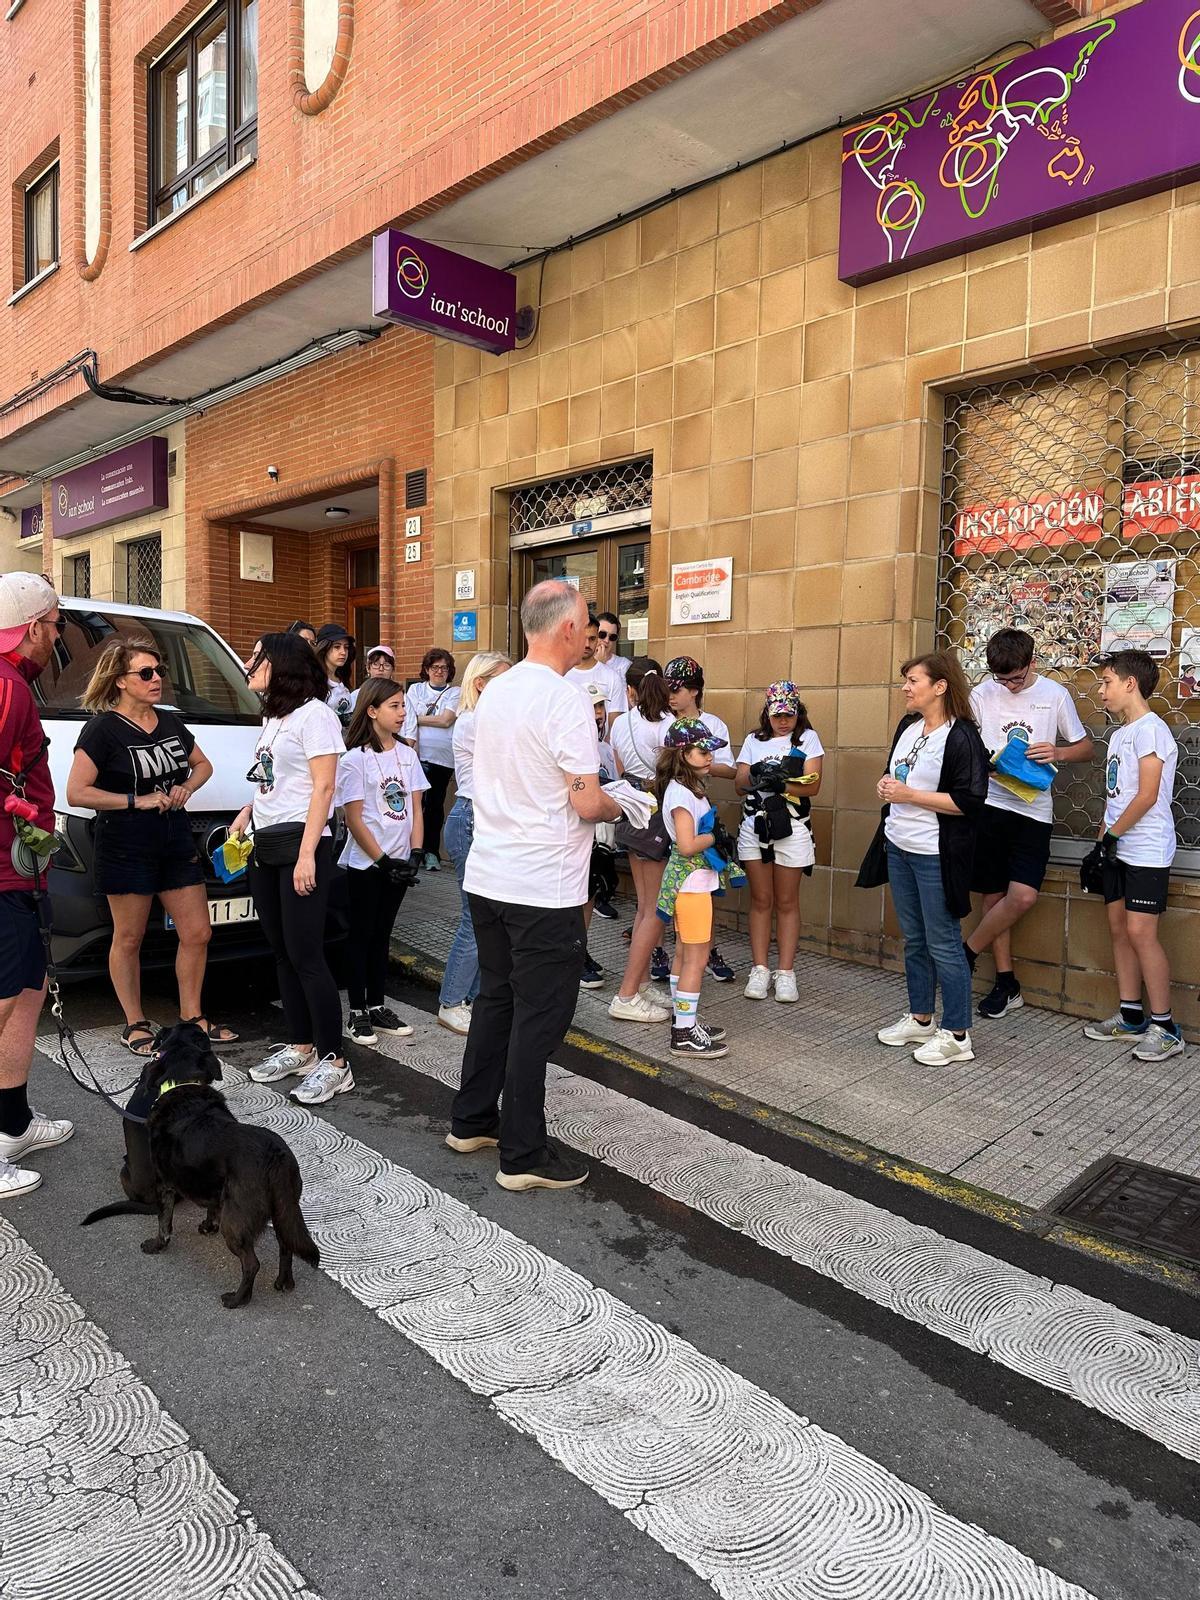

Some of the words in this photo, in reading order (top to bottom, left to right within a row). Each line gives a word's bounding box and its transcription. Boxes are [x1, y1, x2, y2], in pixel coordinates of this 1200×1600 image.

[430, 292, 509, 336] ian'school
[959, 492, 1099, 539] INSCRIPCIÓN
[408, 519, 417, 534] 23
[407, 545, 417, 560] 25
[676, 571, 721, 586] Cambridge
[675, 592, 690, 600] English
[136, 739, 189, 779] ME
